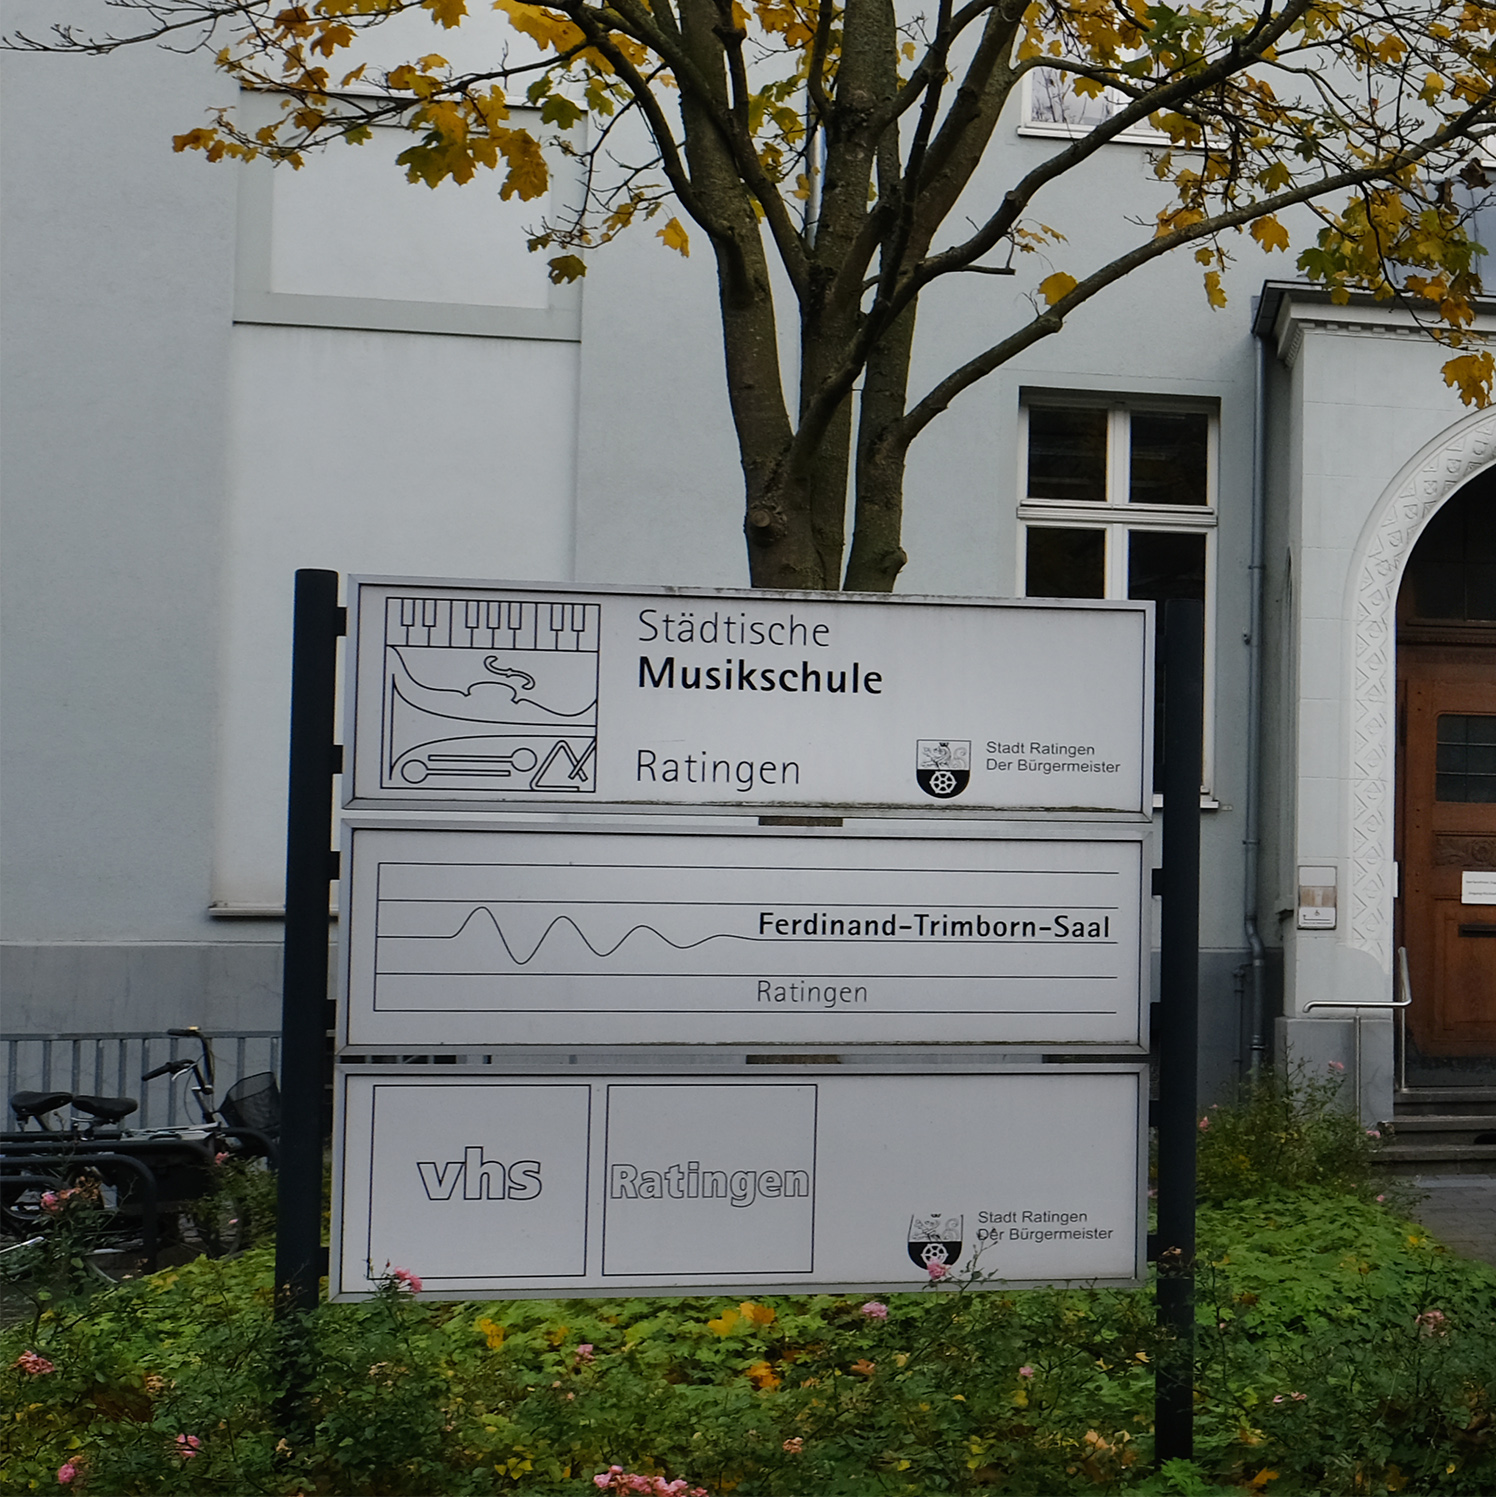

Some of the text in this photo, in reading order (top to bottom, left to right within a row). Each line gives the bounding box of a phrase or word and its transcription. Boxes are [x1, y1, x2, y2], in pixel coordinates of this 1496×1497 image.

[638, 609, 831, 647] Städtische
[638, 655, 883, 695] Musikschule
[985, 740, 1095, 758] Stadt Ratingen
[636, 749, 799, 793] Ratingen
[986, 758, 1121, 775] Der Bürgermeister
[757, 911, 1111, 939] Ferdinand-Trimborn-Saal
[757, 979, 868, 1009] Ratingen
[416, 1145, 810, 1209] vhs Ratingen
[978, 1210, 1088, 1226] Stadt Ratingen
[977, 1227, 1114, 1244] Der Bürgermeister
